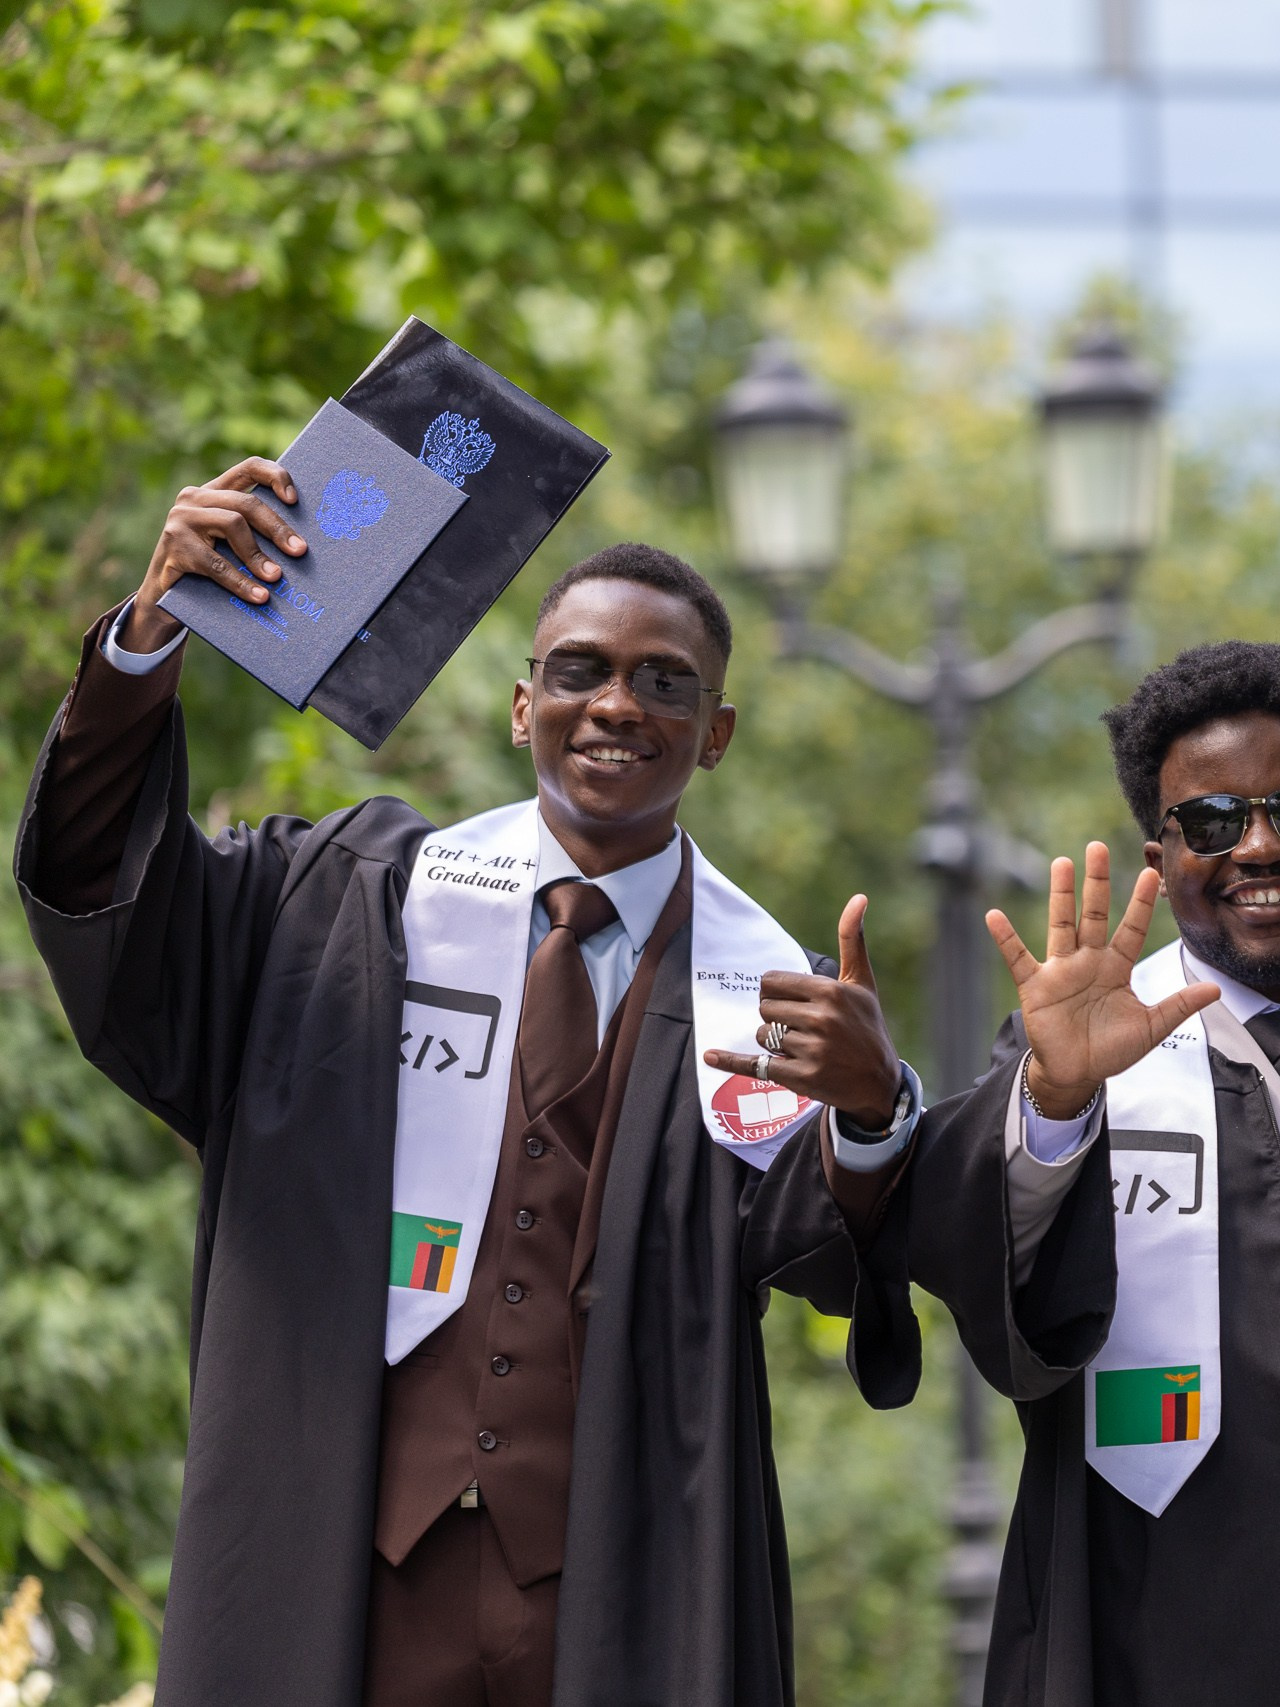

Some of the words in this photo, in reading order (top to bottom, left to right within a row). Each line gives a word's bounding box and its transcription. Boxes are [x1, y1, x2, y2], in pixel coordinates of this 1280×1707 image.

[229, 596, 289, 641] ОБРАЗОВАНИИ
[423, 845, 464, 861] Ctrl
[484, 856, 517, 869] Alt
[427, 865, 521, 893] Graduate
[696, 971, 729, 981] Eng.
[734, 972, 762, 982] Nat
[720, 982, 760, 991] Nyire
